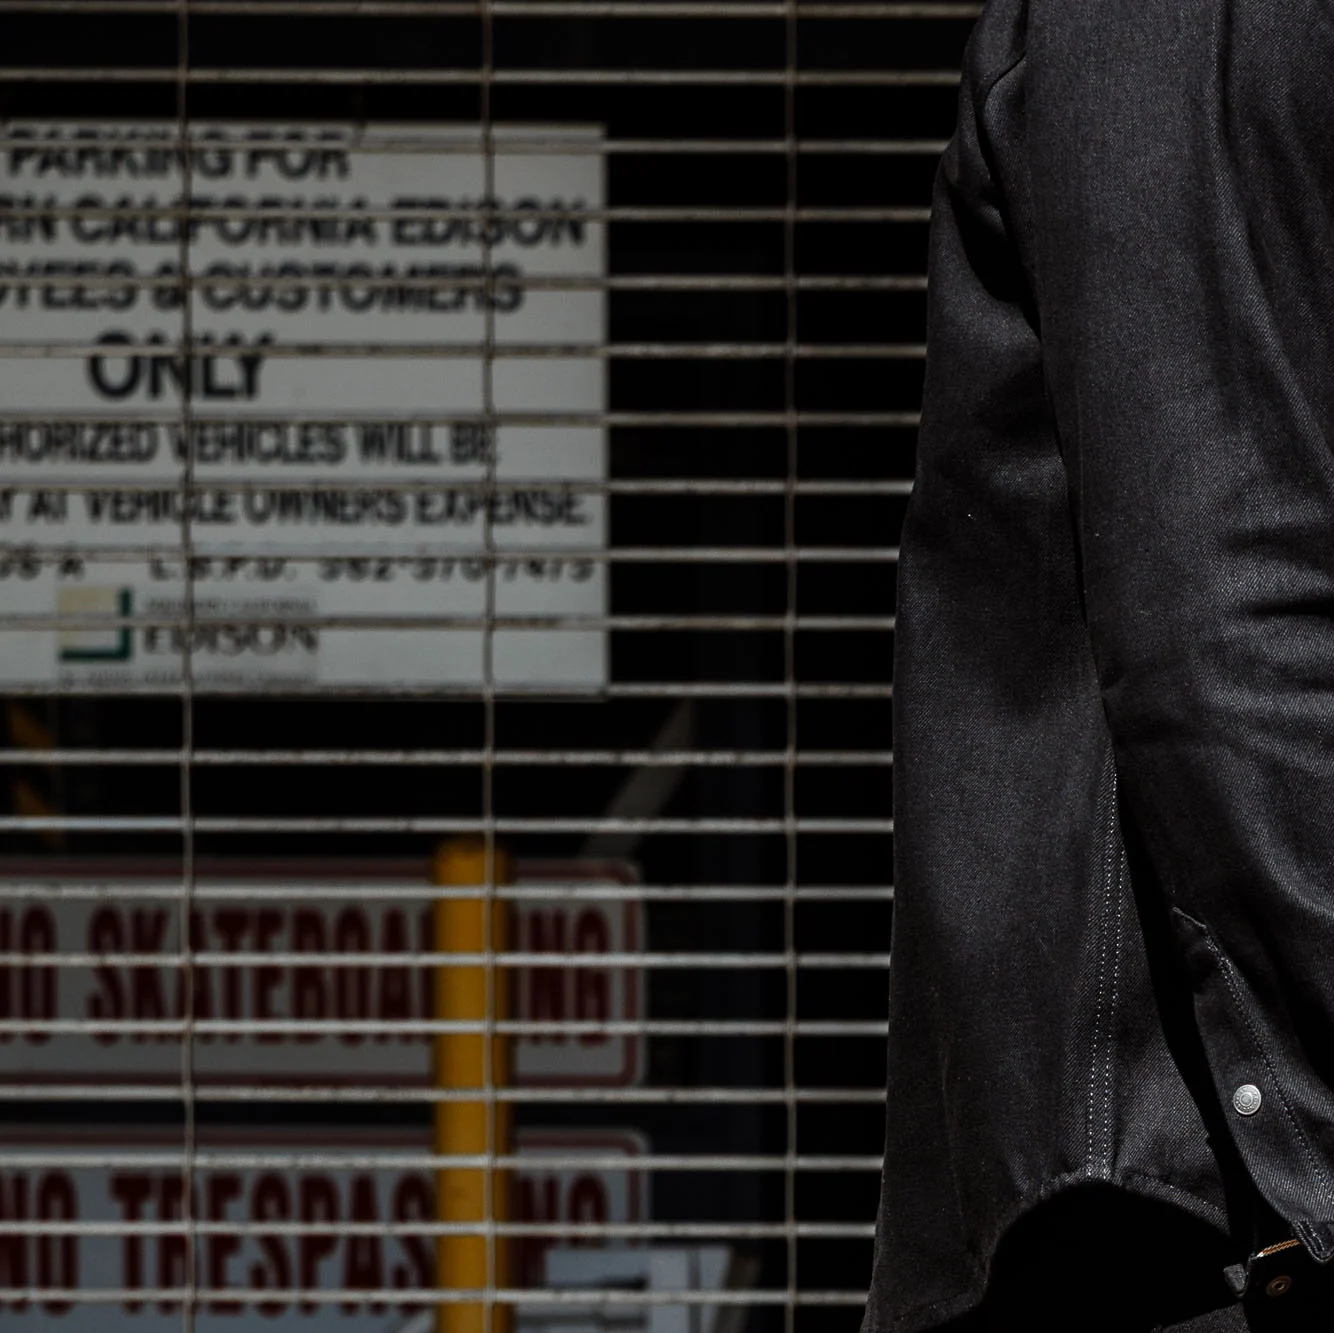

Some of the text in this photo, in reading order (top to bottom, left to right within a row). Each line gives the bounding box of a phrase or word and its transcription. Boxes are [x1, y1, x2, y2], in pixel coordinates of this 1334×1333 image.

[8, 128, 350, 180] PARKING FOR
[72, 196, 374, 244] CALIFORNIA
[393, 196, 585, 245] EDISON
[0, 262, 136, 310] YEES
[202, 262, 524, 312] CUSTOMERS
[88, 332, 273, 399] ONLY
[167, 420, 348, 464] VEHICLES
[355, 420, 440, 465] WILL
[450, 421, 496, 466] BE
[85, 488, 237, 523] VEHICLE
[89, 908, 610, 1045] SKATEBOANG
